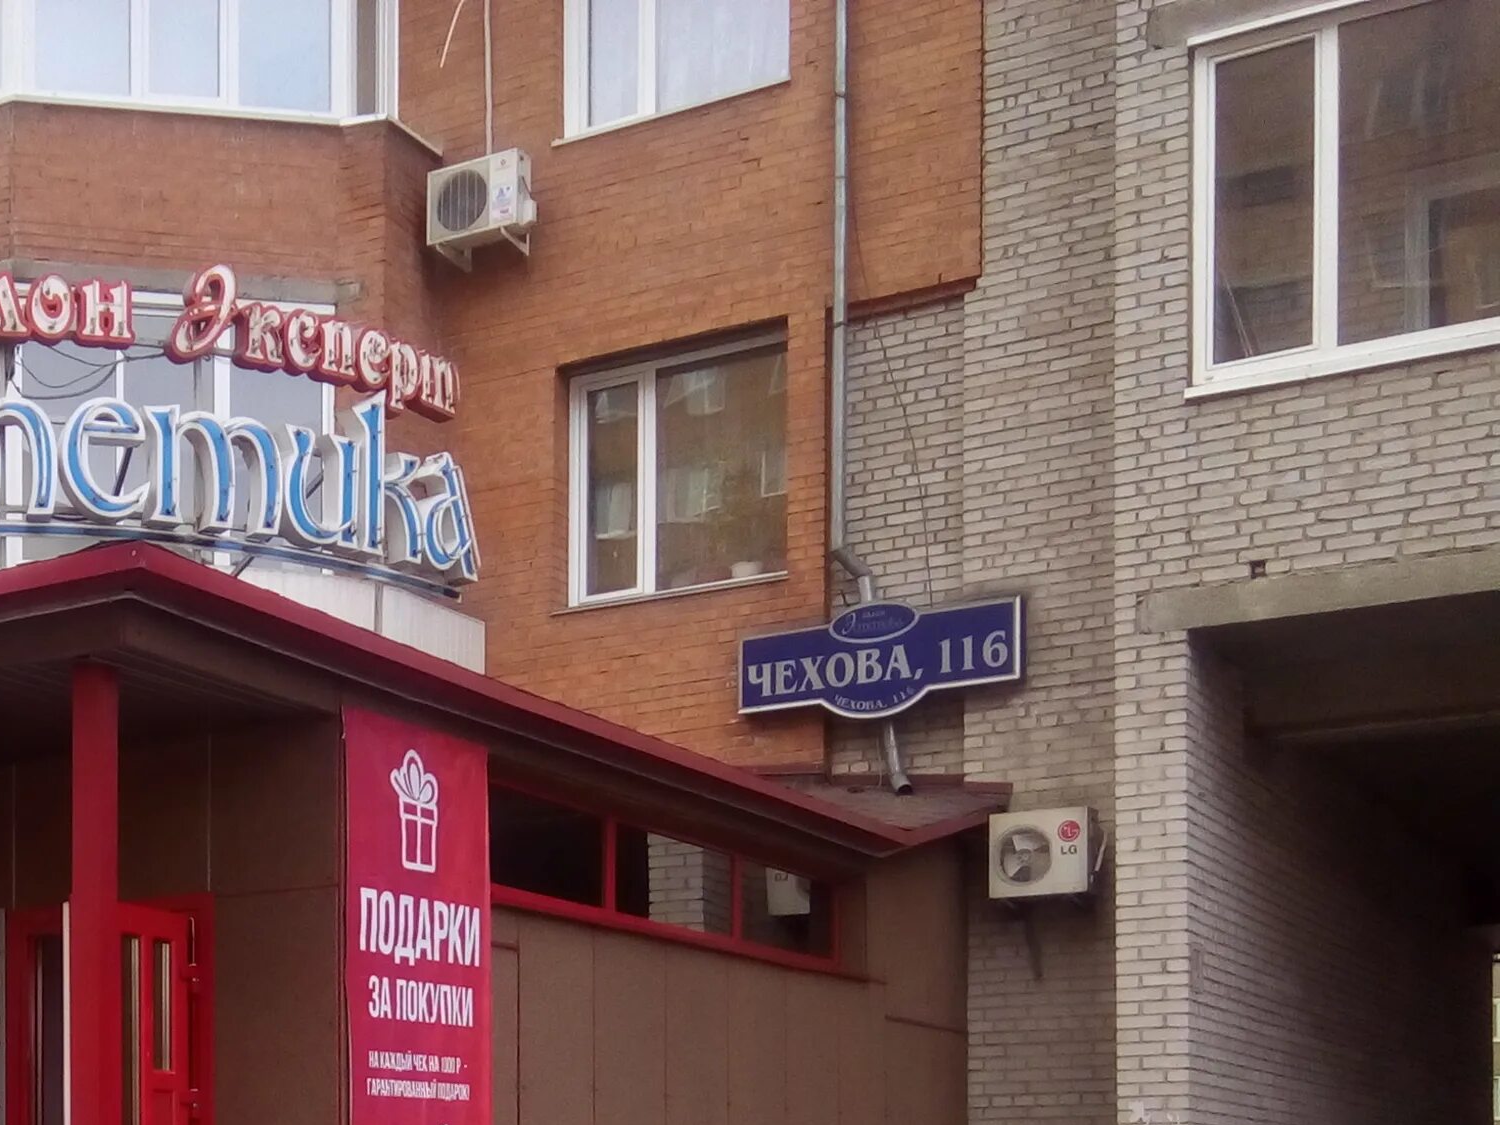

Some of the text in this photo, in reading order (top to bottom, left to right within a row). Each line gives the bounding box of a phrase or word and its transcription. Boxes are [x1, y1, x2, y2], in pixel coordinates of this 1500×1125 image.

[164, 262, 462, 424] Эксперт
[747, 630, 1008, 698] ЧЕХОВА, 116
[1060, 844, 1078, 855] LG
[360, 887, 481, 967] ПОДАРКИ
[368, 975, 474, 1028] ЗА ПОКУПКИ
[413, 1054, 428, 1072] ЧЕК
[428, 1055, 440, 1073] НА
